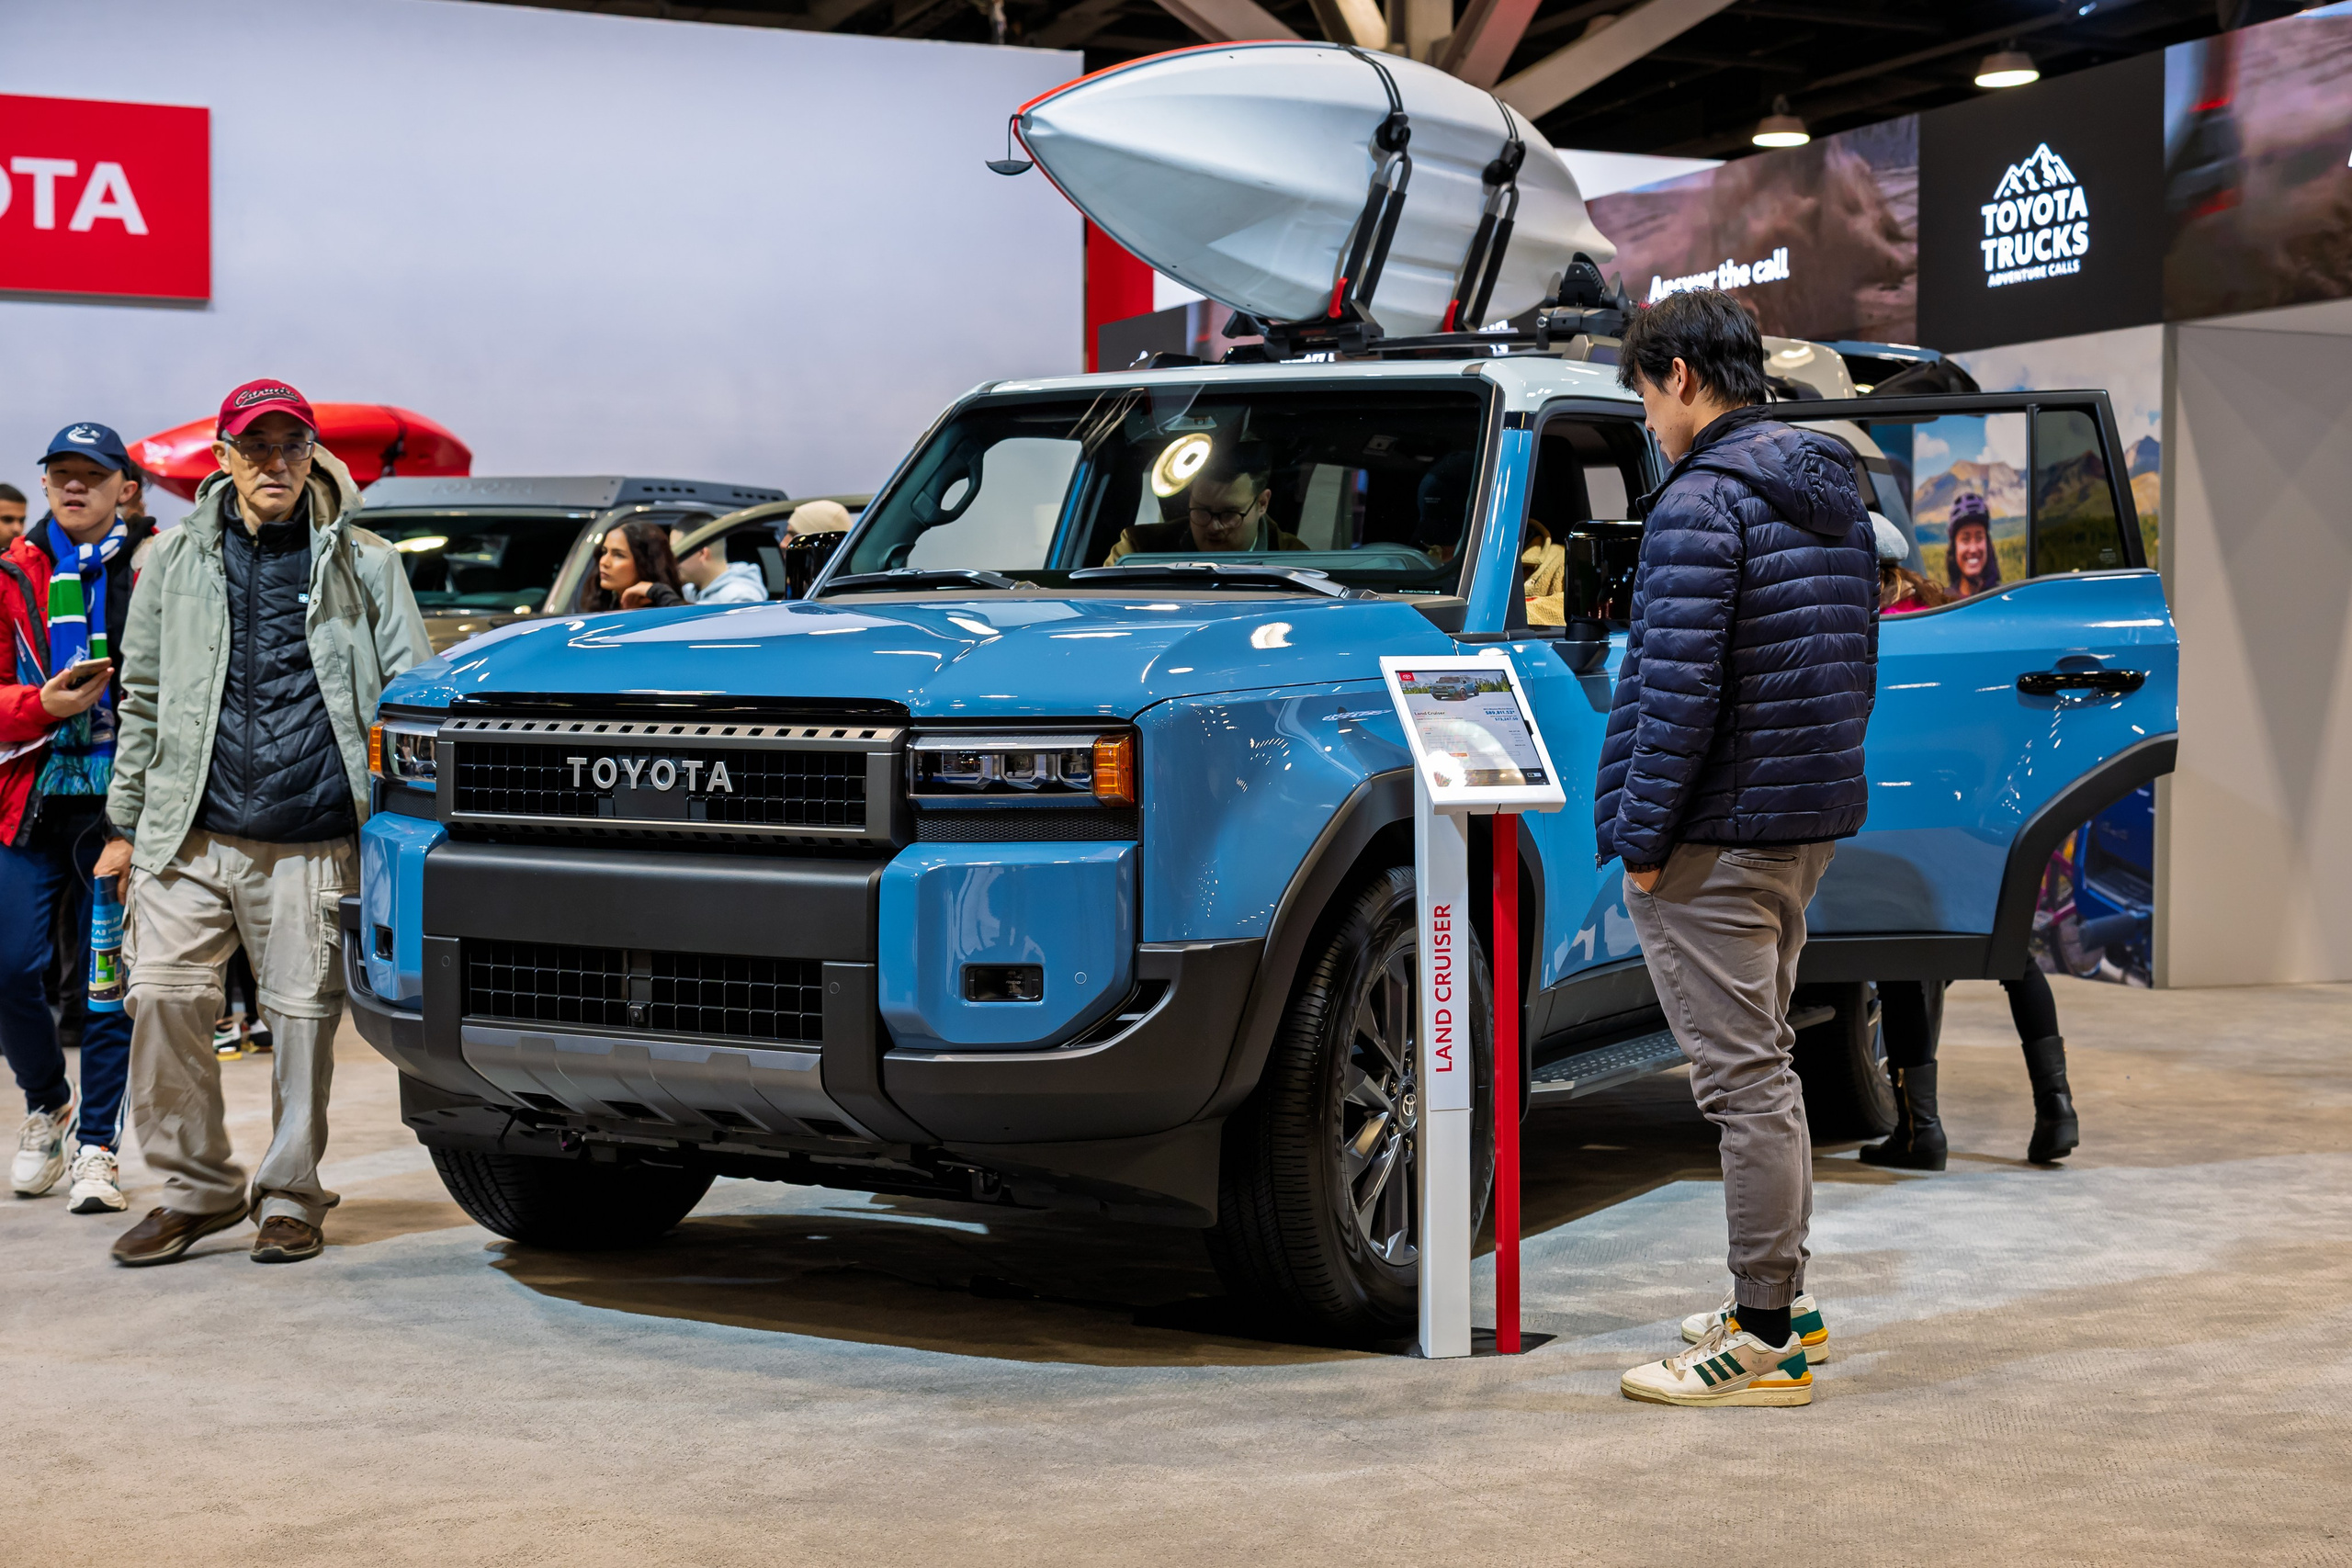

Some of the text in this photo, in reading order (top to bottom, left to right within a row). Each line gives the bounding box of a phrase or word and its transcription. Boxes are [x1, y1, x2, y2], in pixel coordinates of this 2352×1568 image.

[0, 155, 150, 236] TA
[1981, 186, 2089, 236] TOYOTA
[1717, 258, 1751, 290] the
[1752, 247, 1790, 284] call
[1981, 221, 2089, 272] TRUCKS
[1987, 258, 2081, 288] ADVENTURE CALLS
[234, 387, 300, 407] Canada
[566, 757, 733, 793] TOYOTA
[1433, 904, 1453, 1073] LAND CRUISER
[1334, 977, 1365, 1158] DUNLOP
